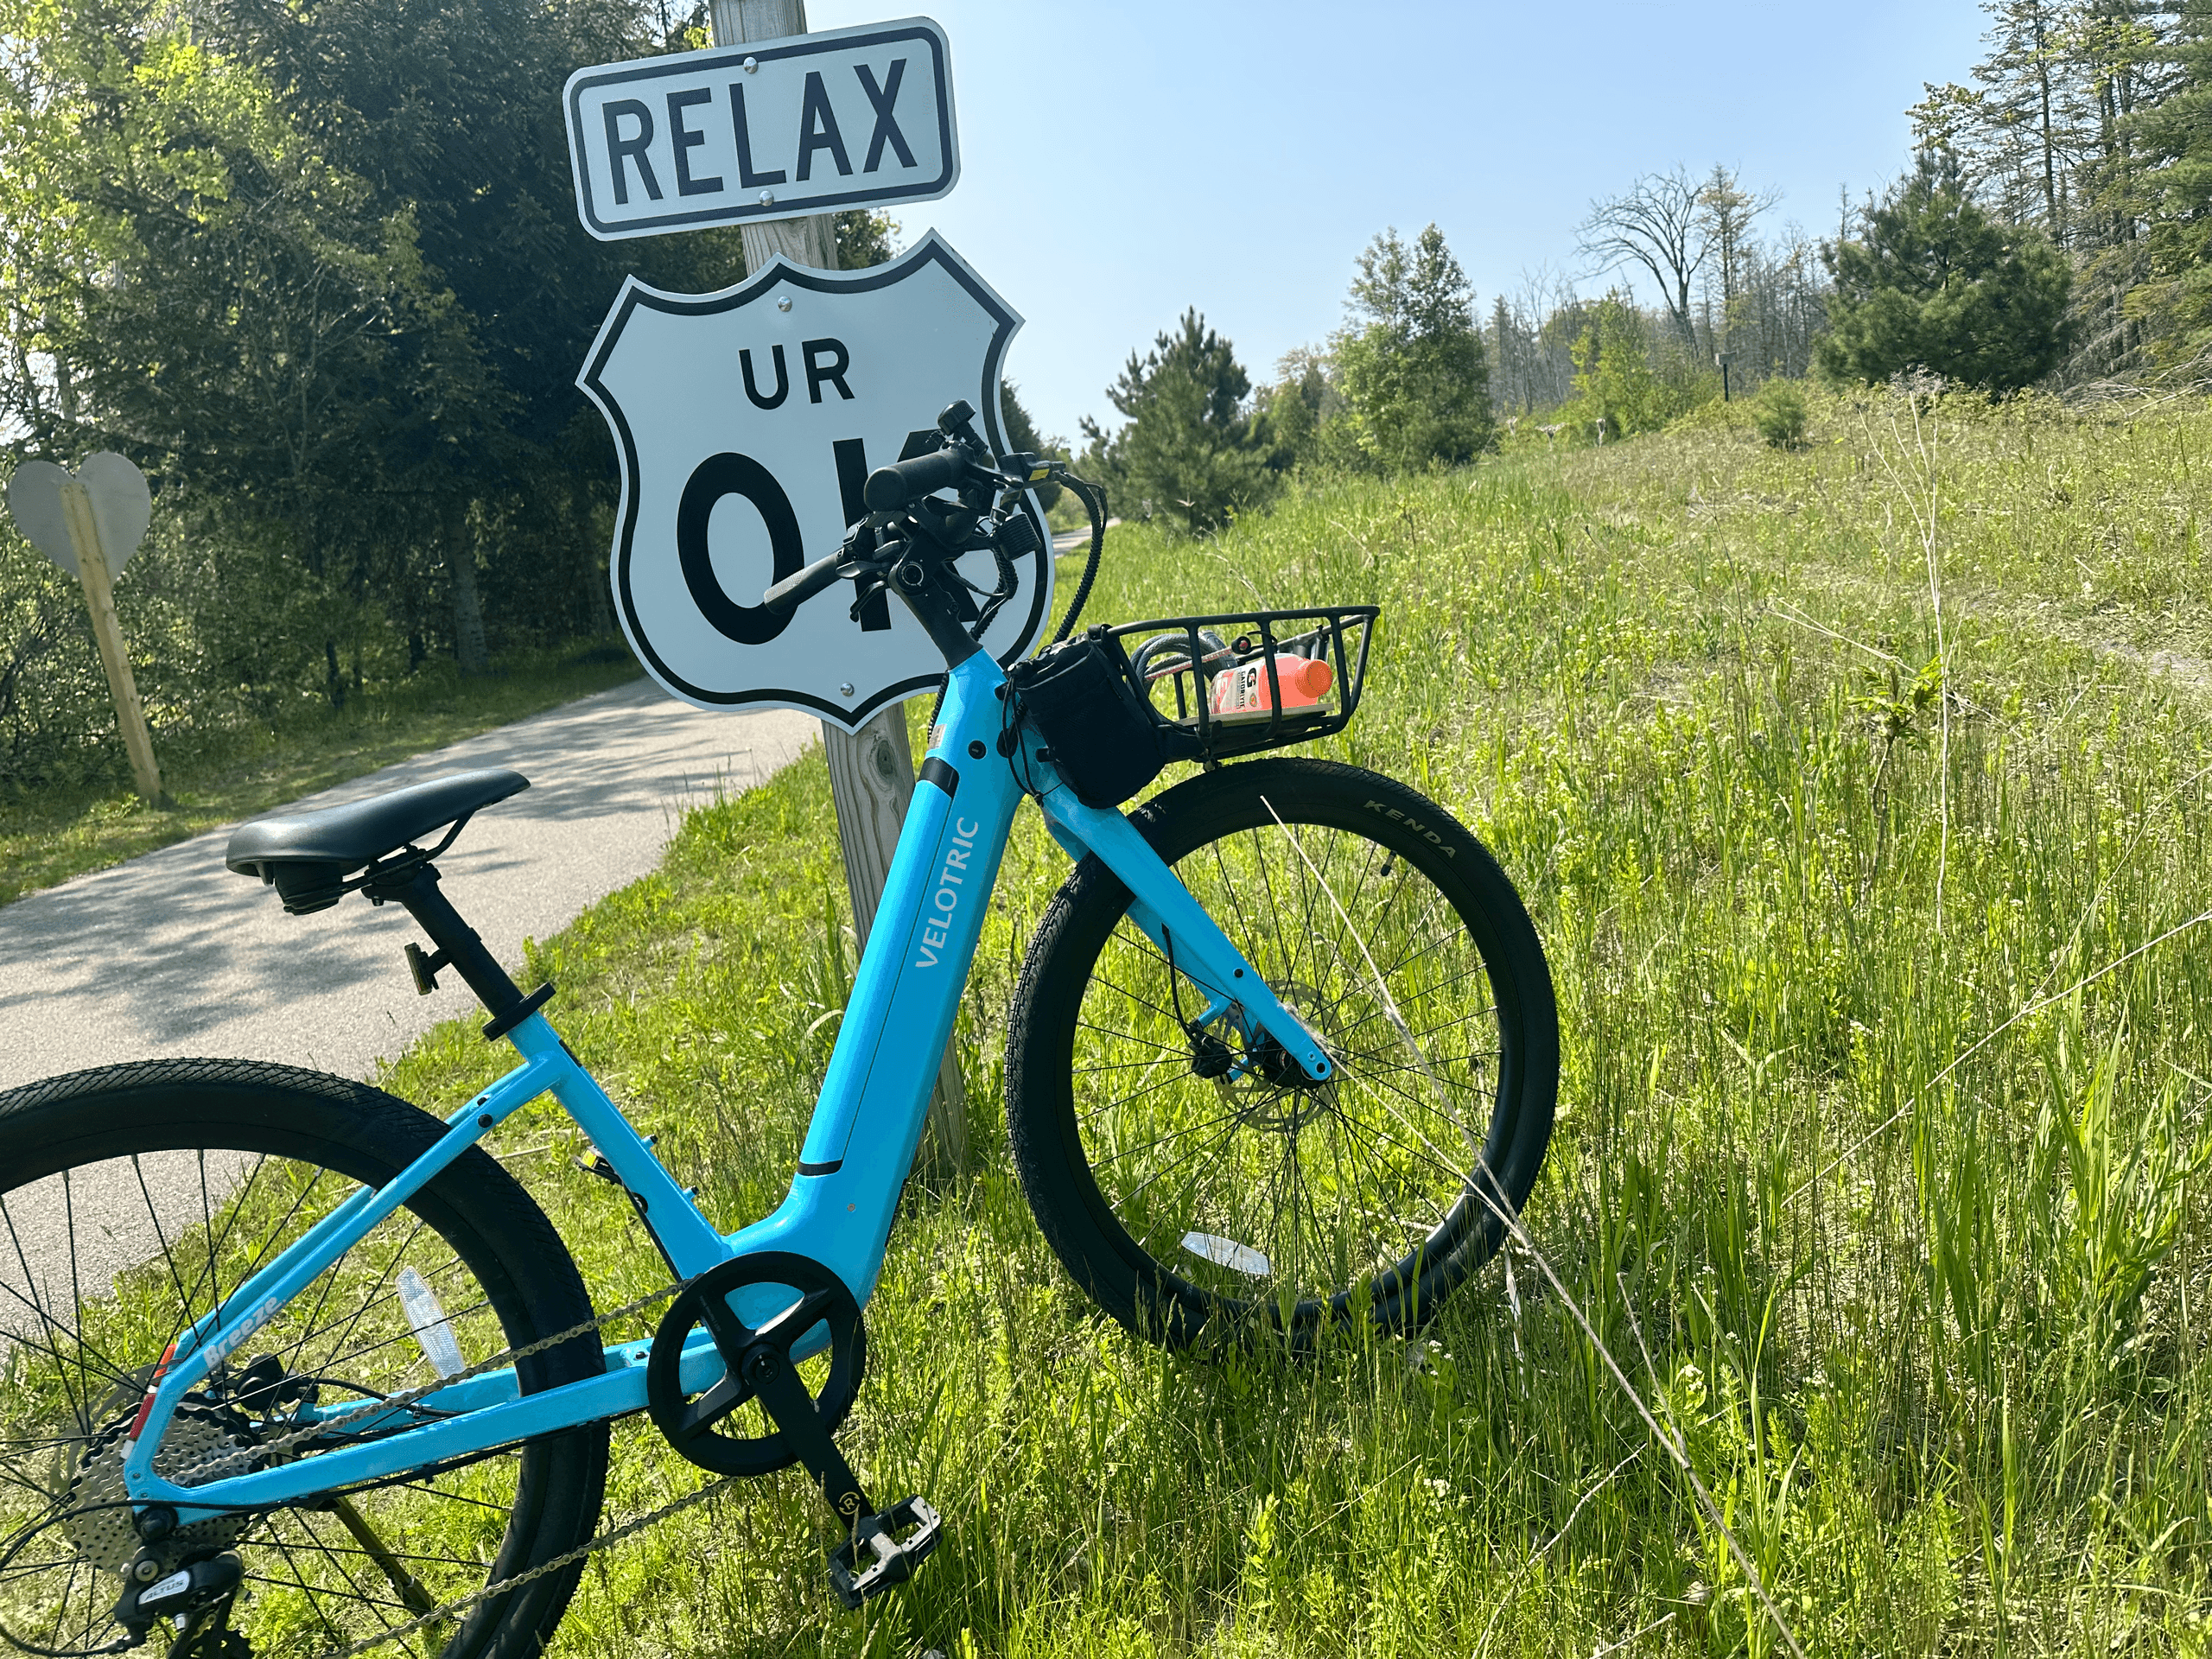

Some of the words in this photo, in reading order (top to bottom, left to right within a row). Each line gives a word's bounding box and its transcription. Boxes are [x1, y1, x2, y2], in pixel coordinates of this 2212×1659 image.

[601, 59, 918, 206] RELAX
[738, 338, 855, 410] UR
[1247, 667, 1257, 689] G
[1363, 800, 1456, 858] KENDA
[915, 817, 979, 969] VELOTRIC
[204, 1297, 283, 1368] Breeze
[144, 1579, 185, 1601] ALTUS
